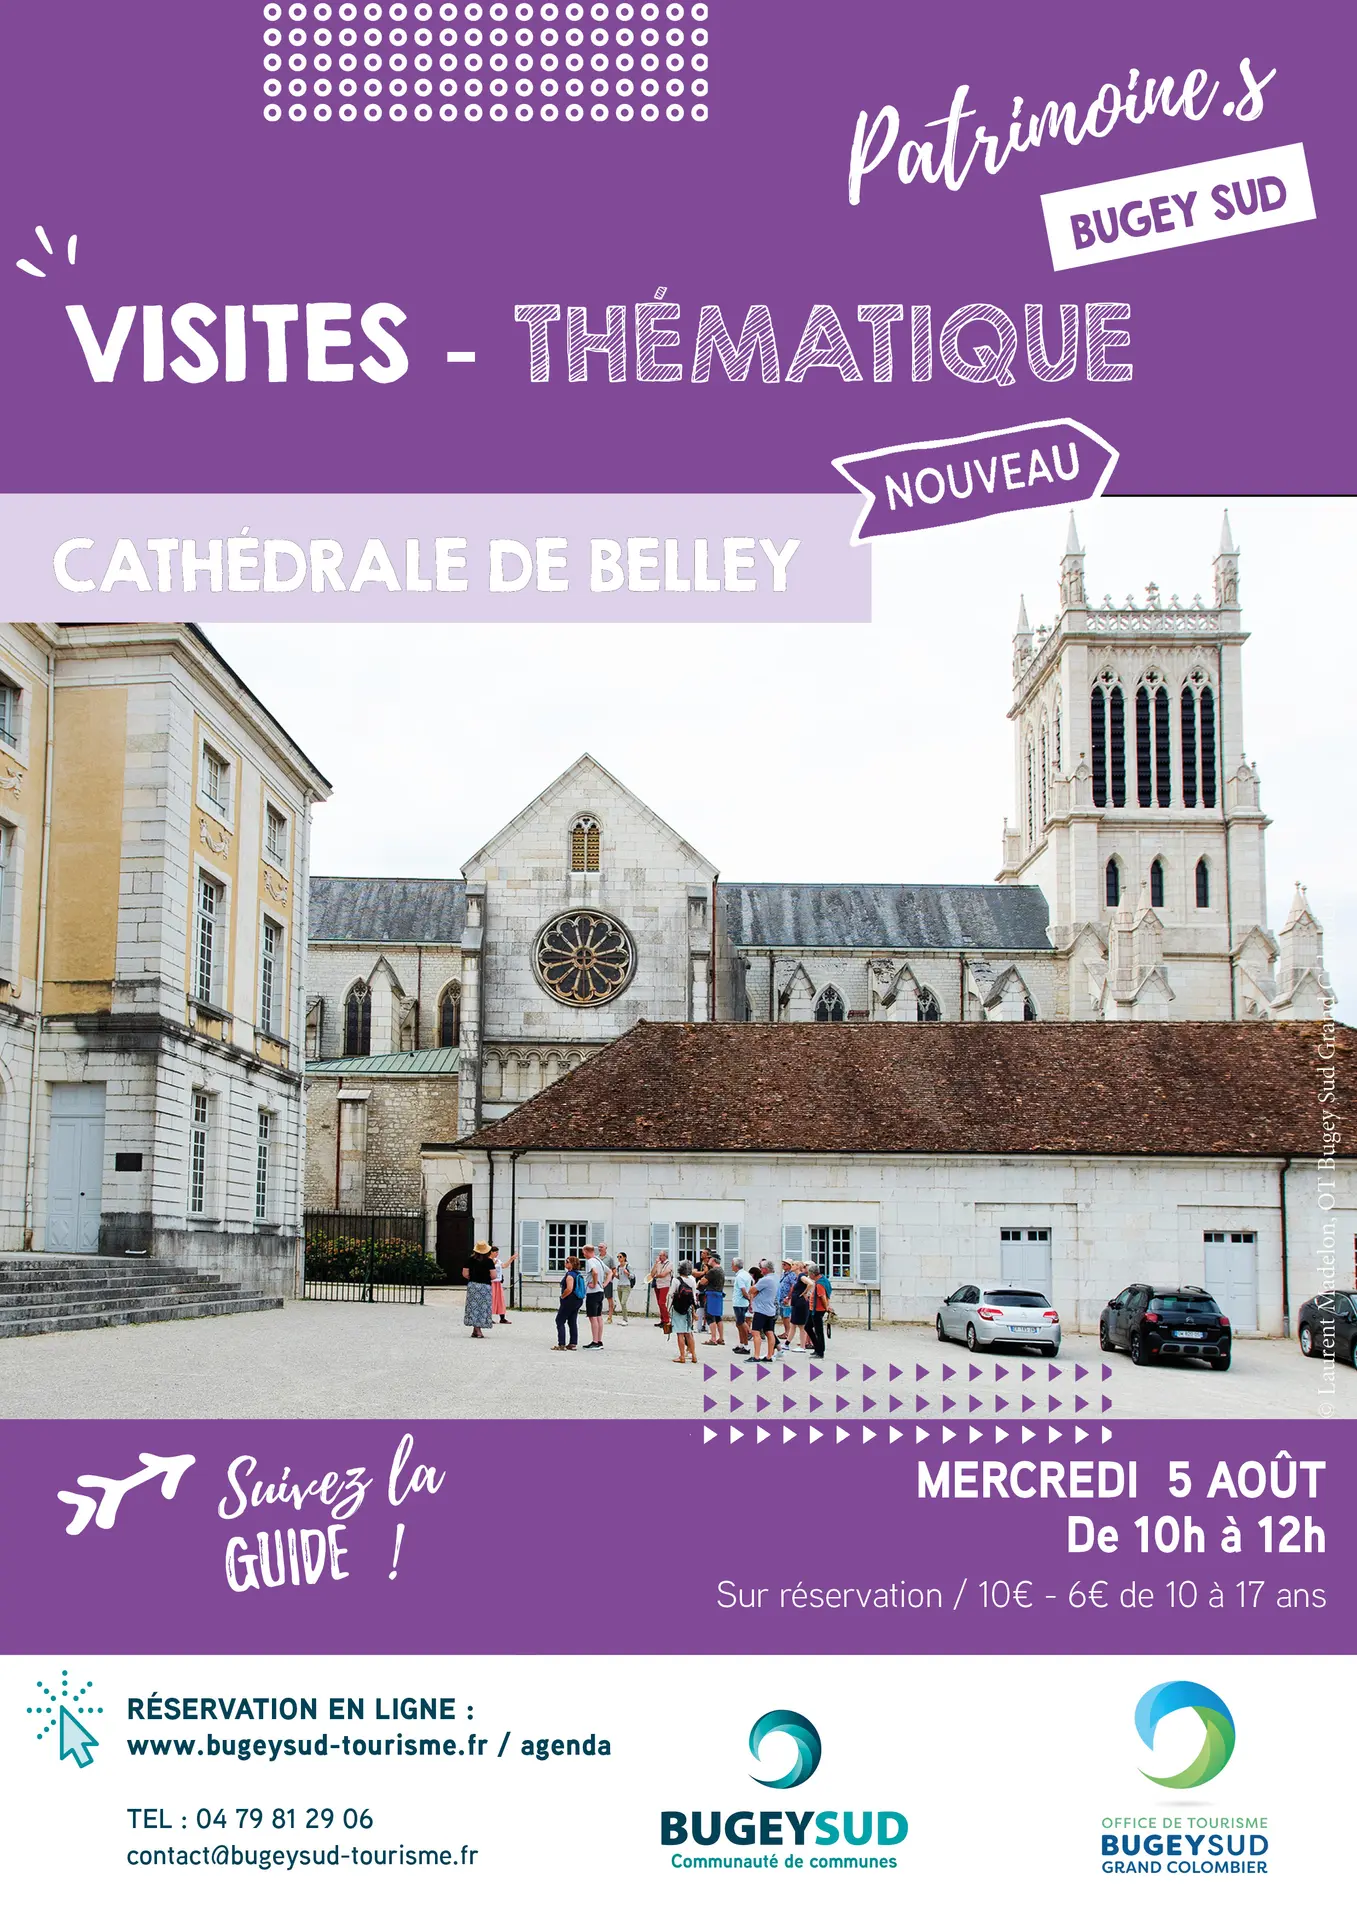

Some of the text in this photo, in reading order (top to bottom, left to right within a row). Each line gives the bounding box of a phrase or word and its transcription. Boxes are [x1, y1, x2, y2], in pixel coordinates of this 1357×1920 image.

[1070, 176, 1287, 250] BUGEY SUD
[65, 287, 1133, 387] VISITES - THÉMATIQUE
[884, 442, 1082, 511] NOUVEAU
[53, 527, 800, 592] CATHÉDRALE DE BELLEY
[218, 1433, 446, 1520] Suivez la
[918, 1450, 1326, 1498] MERCREDI 5 AOÛT
[1068, 1515, 1326, 1553] De 10h à 12h
[225, 1523, 405, 1592] GUIDE !
[717, 1580, 768, 1608] Sur
[780, 1580, 942, 1608] réservation
[953, 1578, 967, 1610] /
[978, 1580, 1033, 1608] 10€
[1068, 1580, 1109, 1608] 6€
[1120, 1580, 1154, 1608] de
[1166, 1580, 1198, 1608] 10
[1208, 1581, 1224, 1608] à
[1236, 1580, 1265, 1608] 17
[1276, 1588, 1326, 1608] ans
[127, 1692, 317, 1720] RÉSERVATION
[329, 1698, 364, 1720] EN
[375, 1697, 456, 1720] LIGNE
[127, 1732, 612, 1762] www.bugeysud-tourisme.fr / agenda
[127, 1808, 173, 1829] TEL
[196, 1808, 227, 1829] 04
[235, 1808, 263, 1829] 79
[271, 1808, 295, 1829] 81
[305, 1808, 334, 1829] 29
[343, 1808, 374, 1829] 06
[661, 1811, 909, 1846] BUGEYSUD
[1101, 1817, 1268, 1829] OFFICE DE TOURISME
[126, 1844, 479, 1871] contact@bugeysud-tourisme.fr
[671, 1853, 898, 1869] Communauté de communes
[1101, 1834, 1269, 1857] BUGEYSUD
[1101, 1860, 1268, 1874] GRAND COLOMBIER
